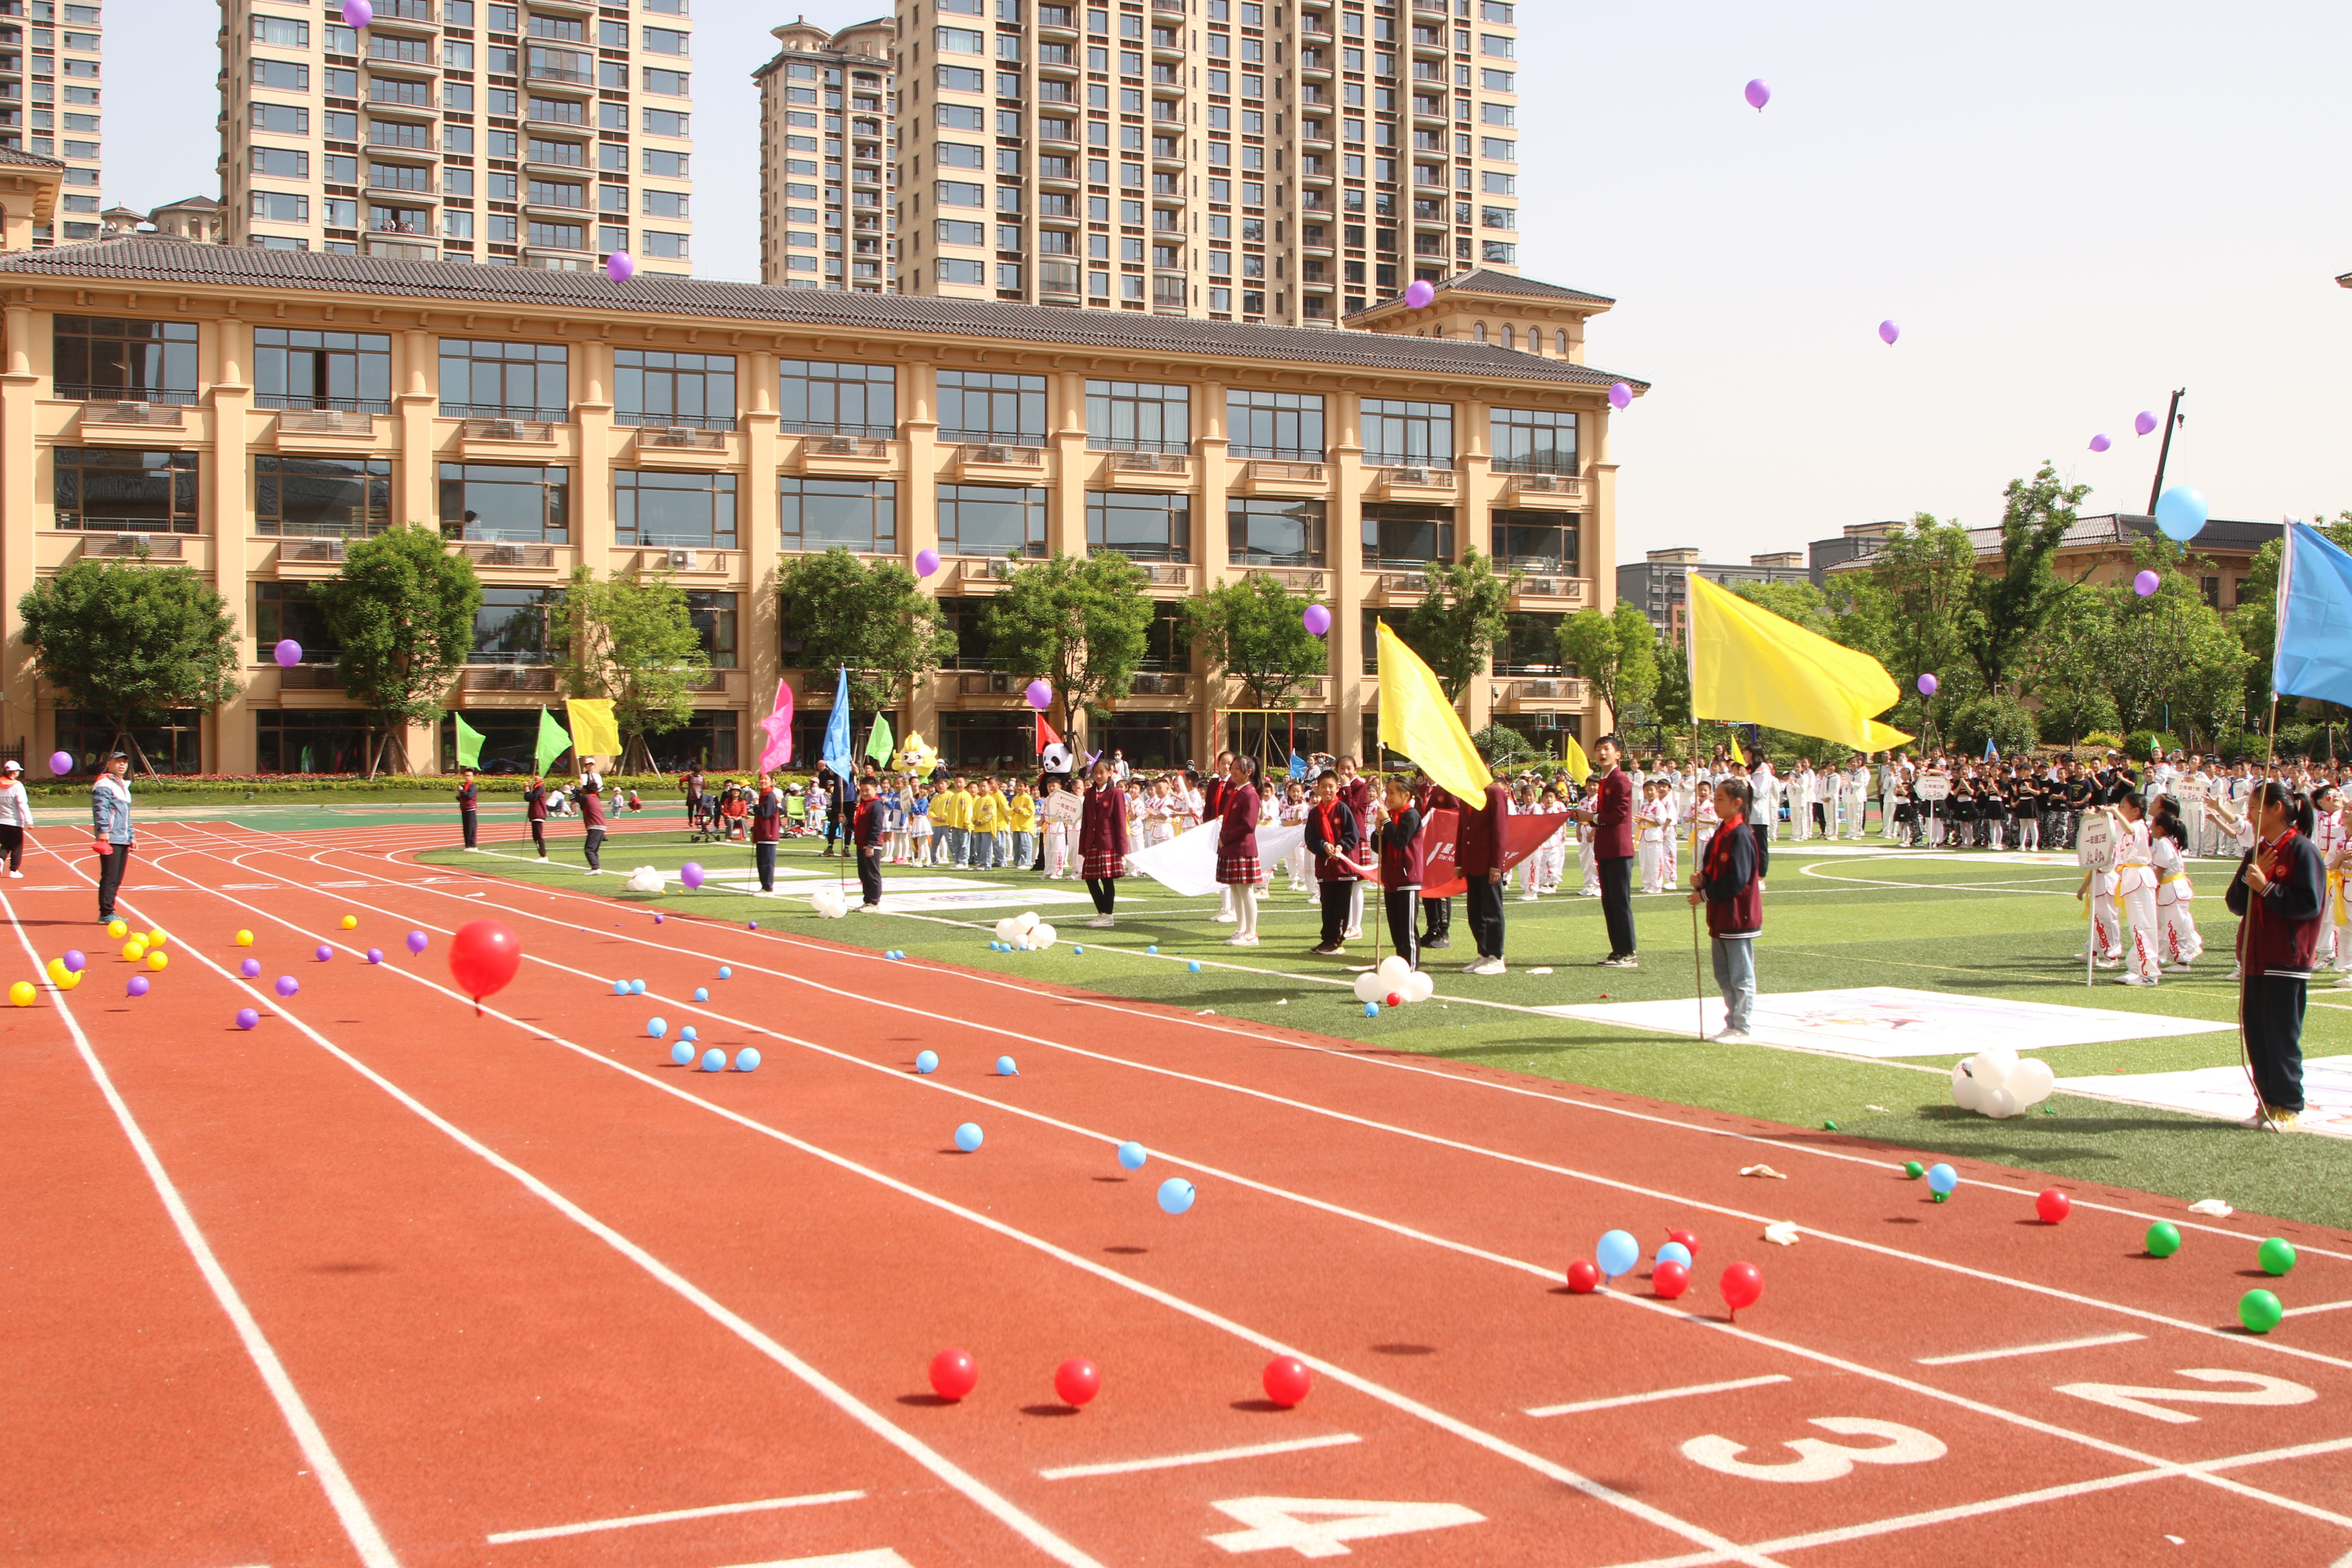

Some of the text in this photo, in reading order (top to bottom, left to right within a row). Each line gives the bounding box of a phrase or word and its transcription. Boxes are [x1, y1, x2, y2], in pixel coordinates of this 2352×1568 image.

[1056, 802, 1077, 814] 一年级3班
[2085, 833, 2106, 845] 一年级2班
[2052, 1368, 2318, 1424] 2
[1680, 1417, 1948, 1482] 3
[1204, 1495, 1488, 1559] 4
